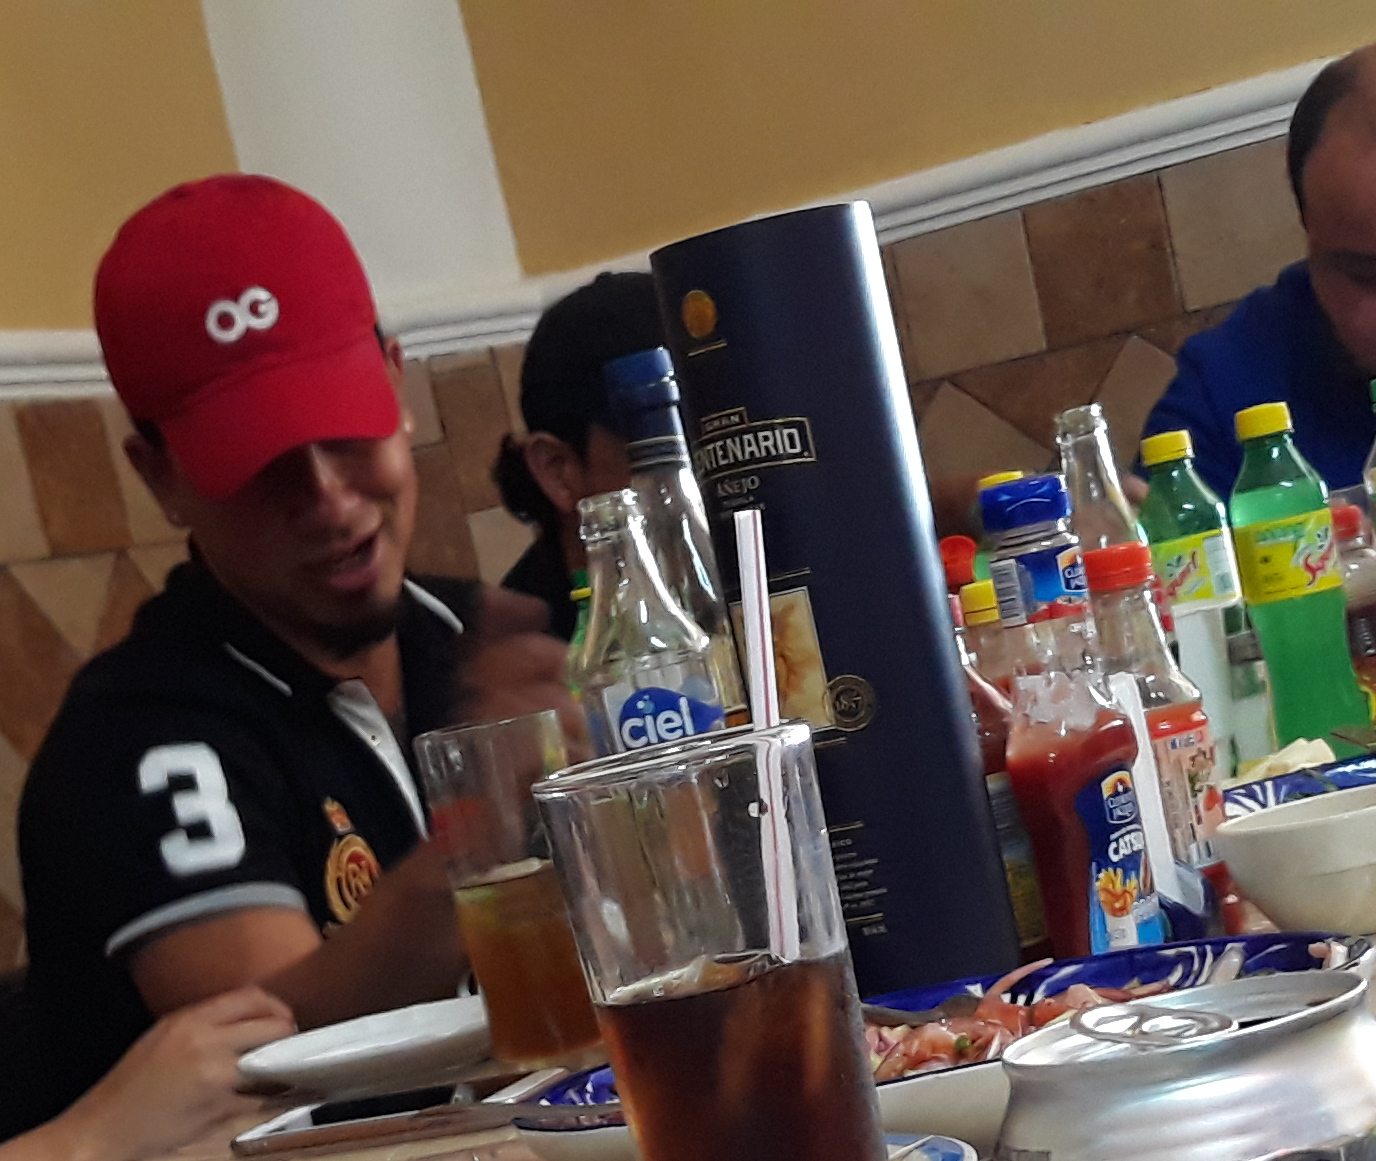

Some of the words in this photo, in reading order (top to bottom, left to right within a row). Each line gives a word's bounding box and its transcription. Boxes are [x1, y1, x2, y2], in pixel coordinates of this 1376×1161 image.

[205, 287, 279, 343] OG
[621, 696, 696, 749] ciel
[138, 741, 246, 875] 3
